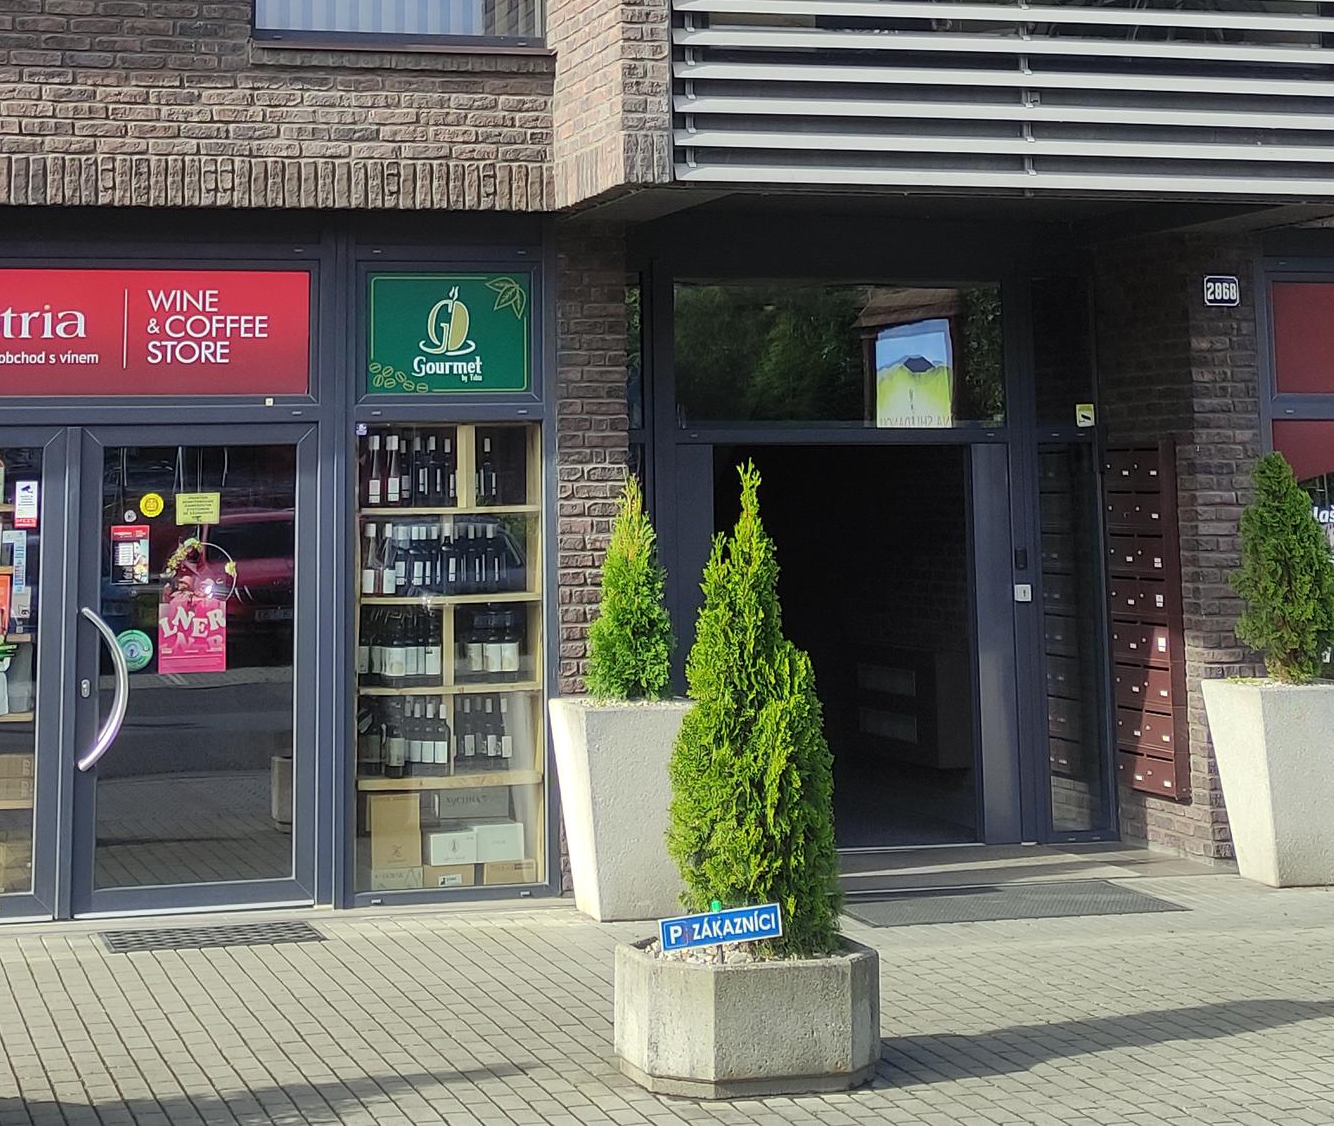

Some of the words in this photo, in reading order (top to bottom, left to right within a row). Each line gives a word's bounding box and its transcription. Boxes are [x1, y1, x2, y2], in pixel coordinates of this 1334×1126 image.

[147, 289, 219, 312] WINE
[1207, 282, 1237, 300] 2868
[147, 318, 160, 334] &
[165, 315, 268, 338] COFFEE
[49, 353, 56, 364] s
[60, 350, 99, 364] vínem
[147, 341, 230, 364] STORE
[412, 356, 482, 377] Gourmet
[669, 926, 683, 945] P
[692, 911, 776, 940] ZÁKAZNÍCI
